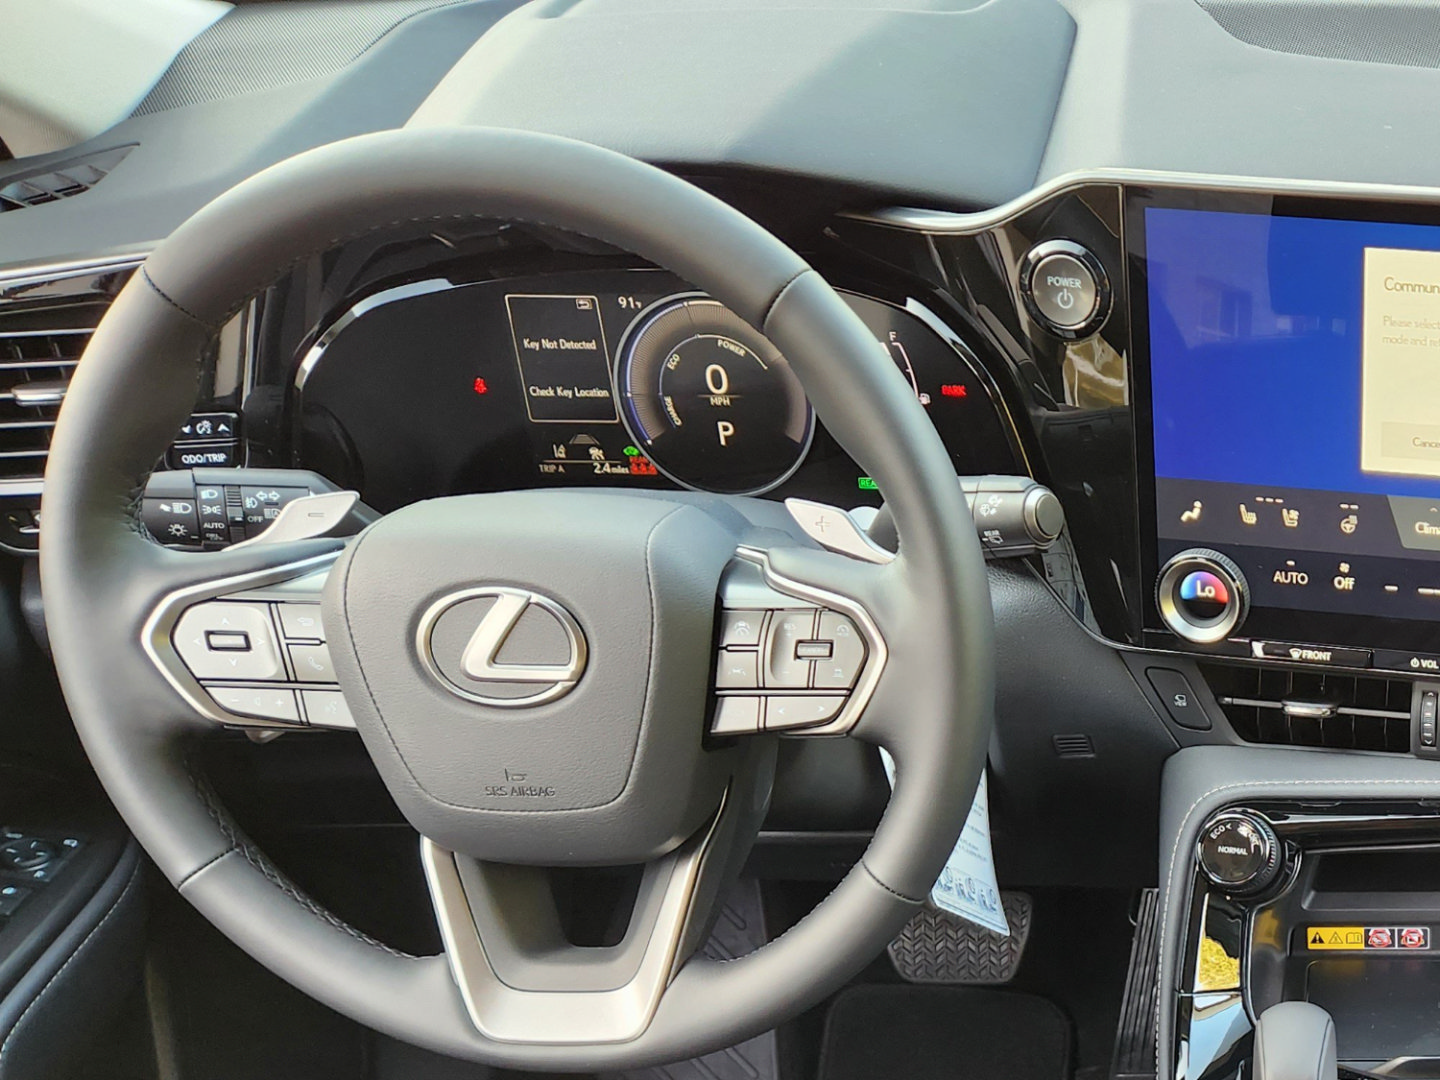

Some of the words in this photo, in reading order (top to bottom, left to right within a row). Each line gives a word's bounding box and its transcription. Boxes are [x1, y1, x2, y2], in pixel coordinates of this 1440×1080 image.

[1047, 276, 1082, 289] POWER
[1383, 315, 1412, 328] Please
[1414, 318, 1440, 331] select
[889, 331, 897, 341] F
[1382, 334, 1409, 345] mode
[1410, 335, 1428, 347] and
[523, 338, 540, 351] Key
[541, 338, 558, 349] Not
[559, 338, 597, 350] Detected
[717, 339, 747, 357] POWER
[667, 353, 681, 371] ECO
[705, 364, 729, 394] 0
[529, 385, 555, 397] Check
[556, 386, 573, 399] Key
[574, 386, 610, 398] Location
[710, 397, 731, 407] MPH
[717, 420, 735, 446] P
[181, 453, 227, 464] ODO/TRIP
[539, 464, 556, 473] TRIP
[557, 464, 566, 473] A
[247, 515, 264, 523] OFF
[1273, 570, 1308, 585] AUTO
[1333, 575, 1356, 591] Off
[1196, 579, 1216, 598] Lo
[1301, 649, 1332, 662] FRONT
[1420, 659, 1439, 669] VOL
[485, 786, 508, 797] SRS
[510, 786, 556, 797] AIRBAG
[1209, 824, 1226, 840] ECO
[1217, 845, 1249, 856] NORMAL
